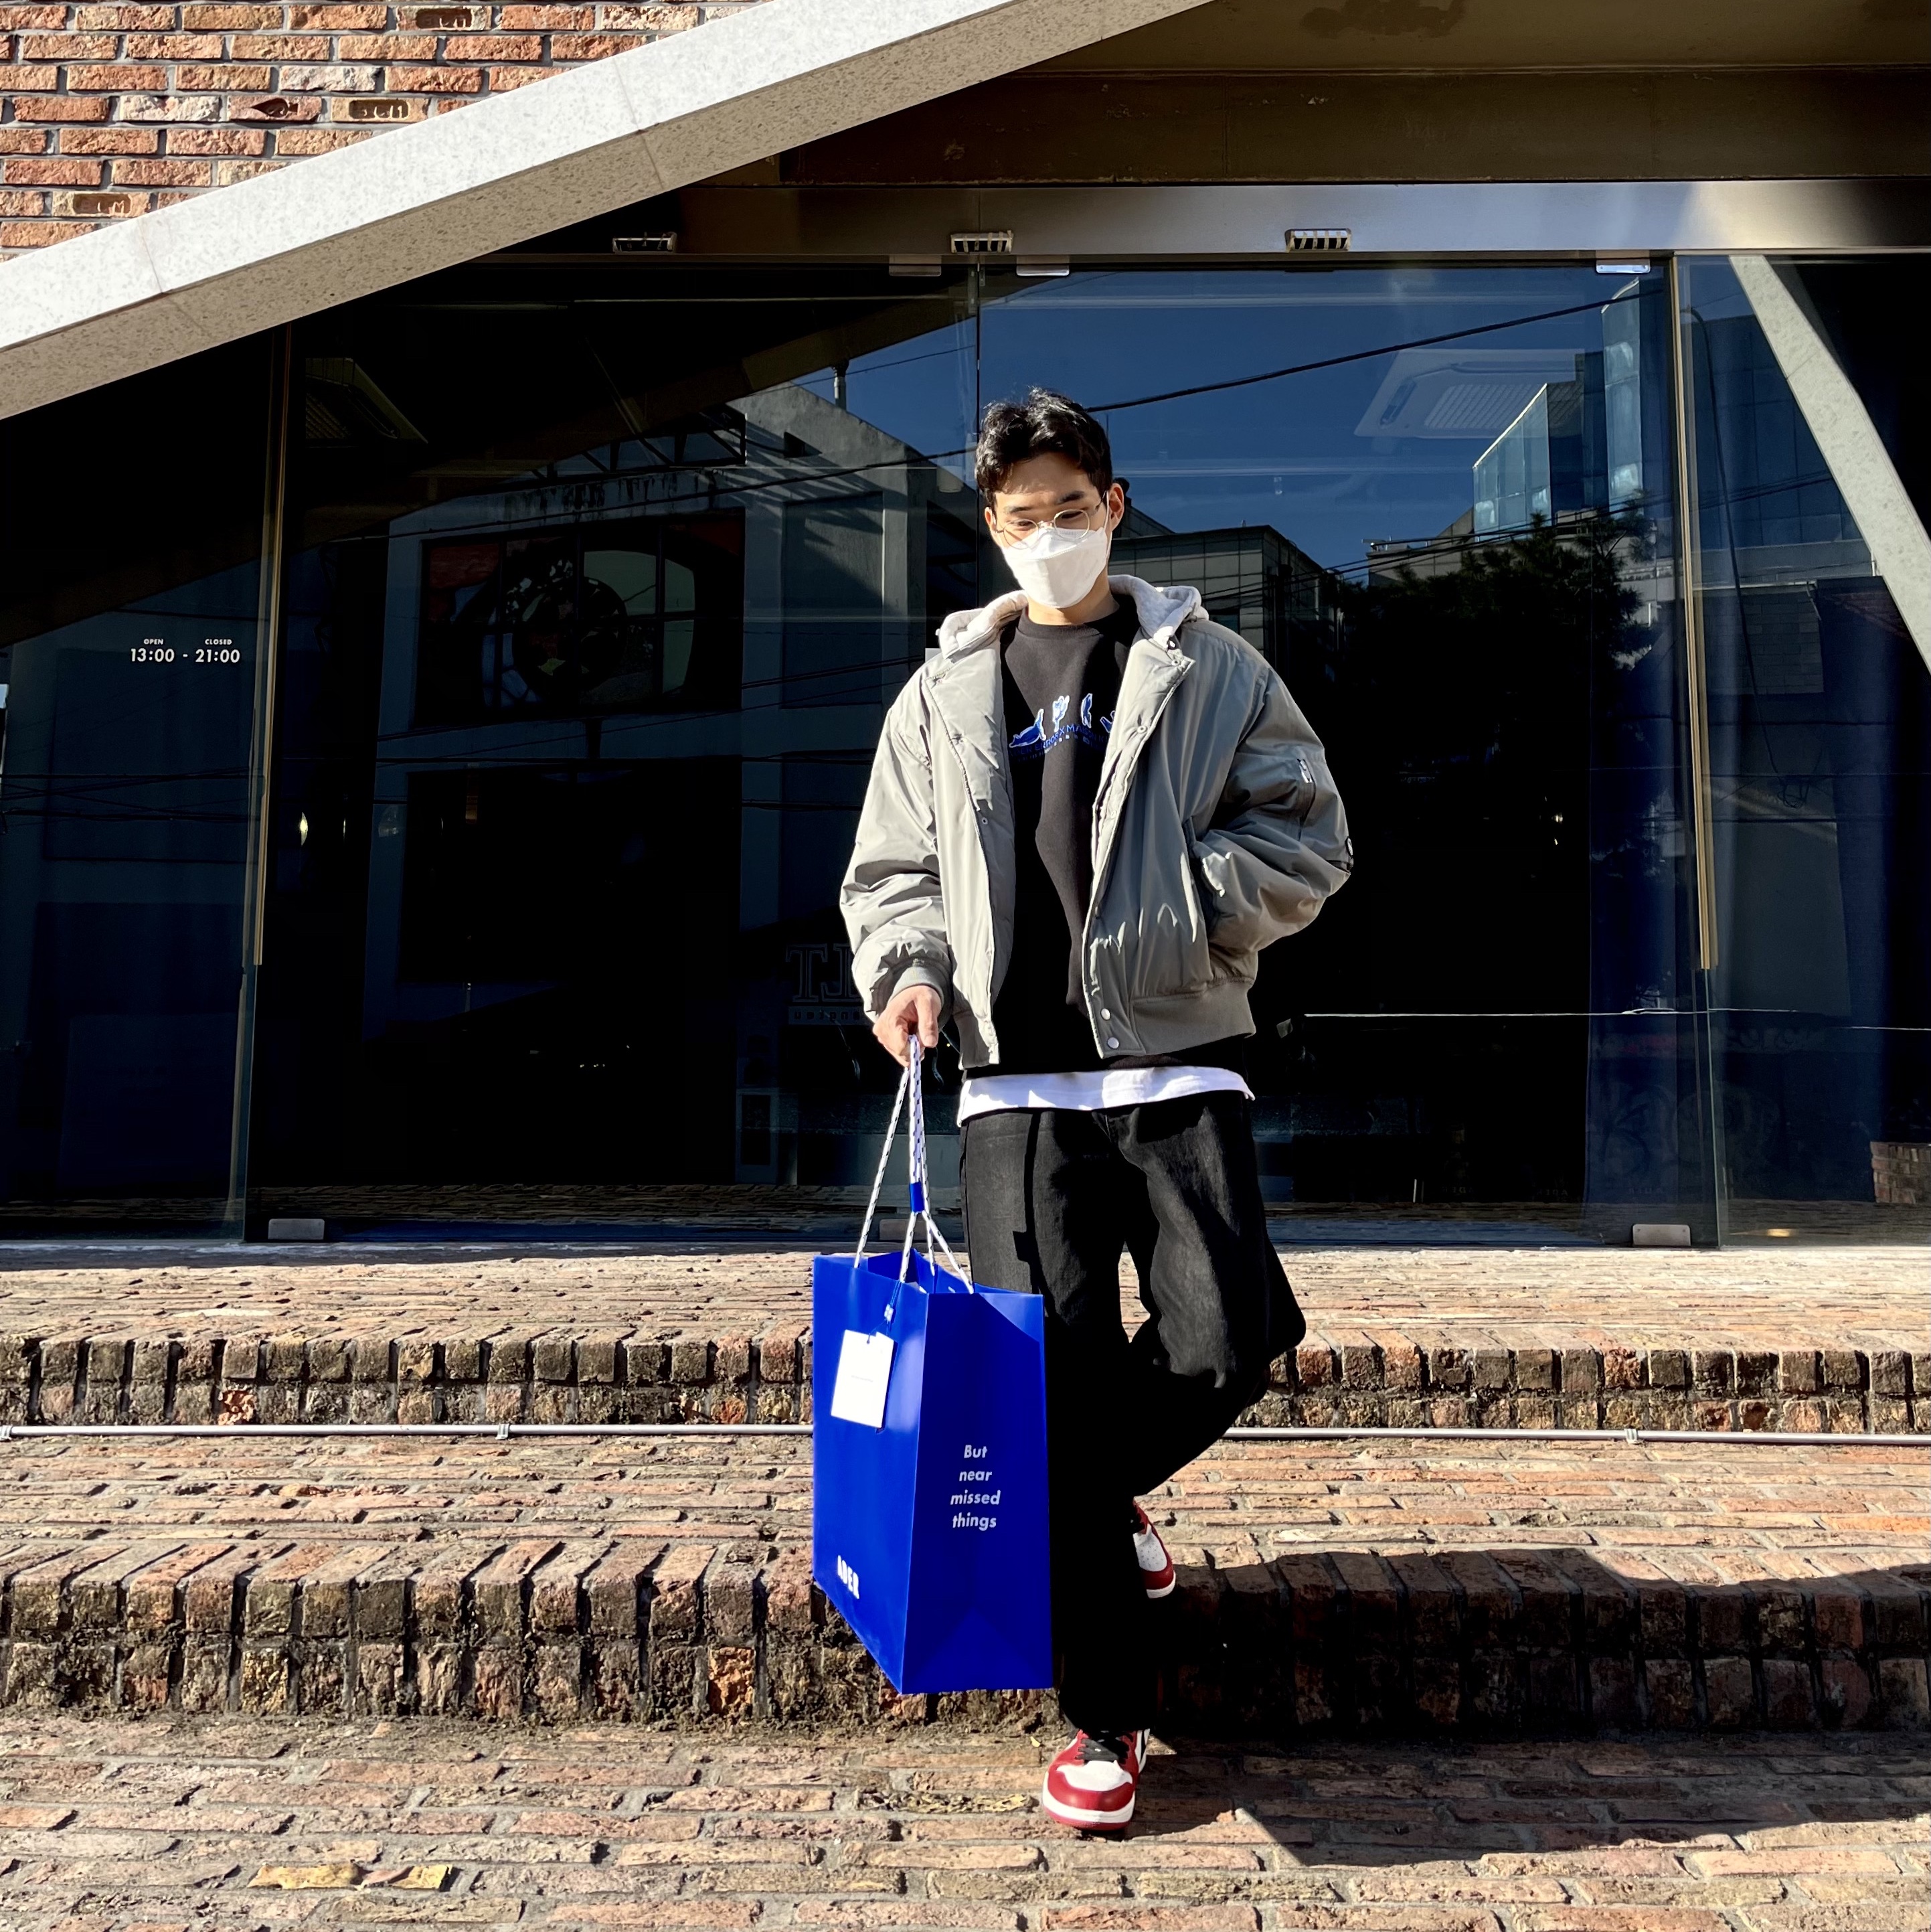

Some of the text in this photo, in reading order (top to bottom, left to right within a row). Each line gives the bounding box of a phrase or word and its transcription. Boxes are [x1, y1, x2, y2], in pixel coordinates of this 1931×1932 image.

[131, 648, 175, 662] 13:00
[195, 649, 240, 663] 21:00
[964, 1445, 988, 1458] But
[959, 1471, 993, 1481] near
[950, 1490, 1001, 1506] missed
[952, 1512, 997, 1531] things
[837, 1554, 860, 1599] ADER
